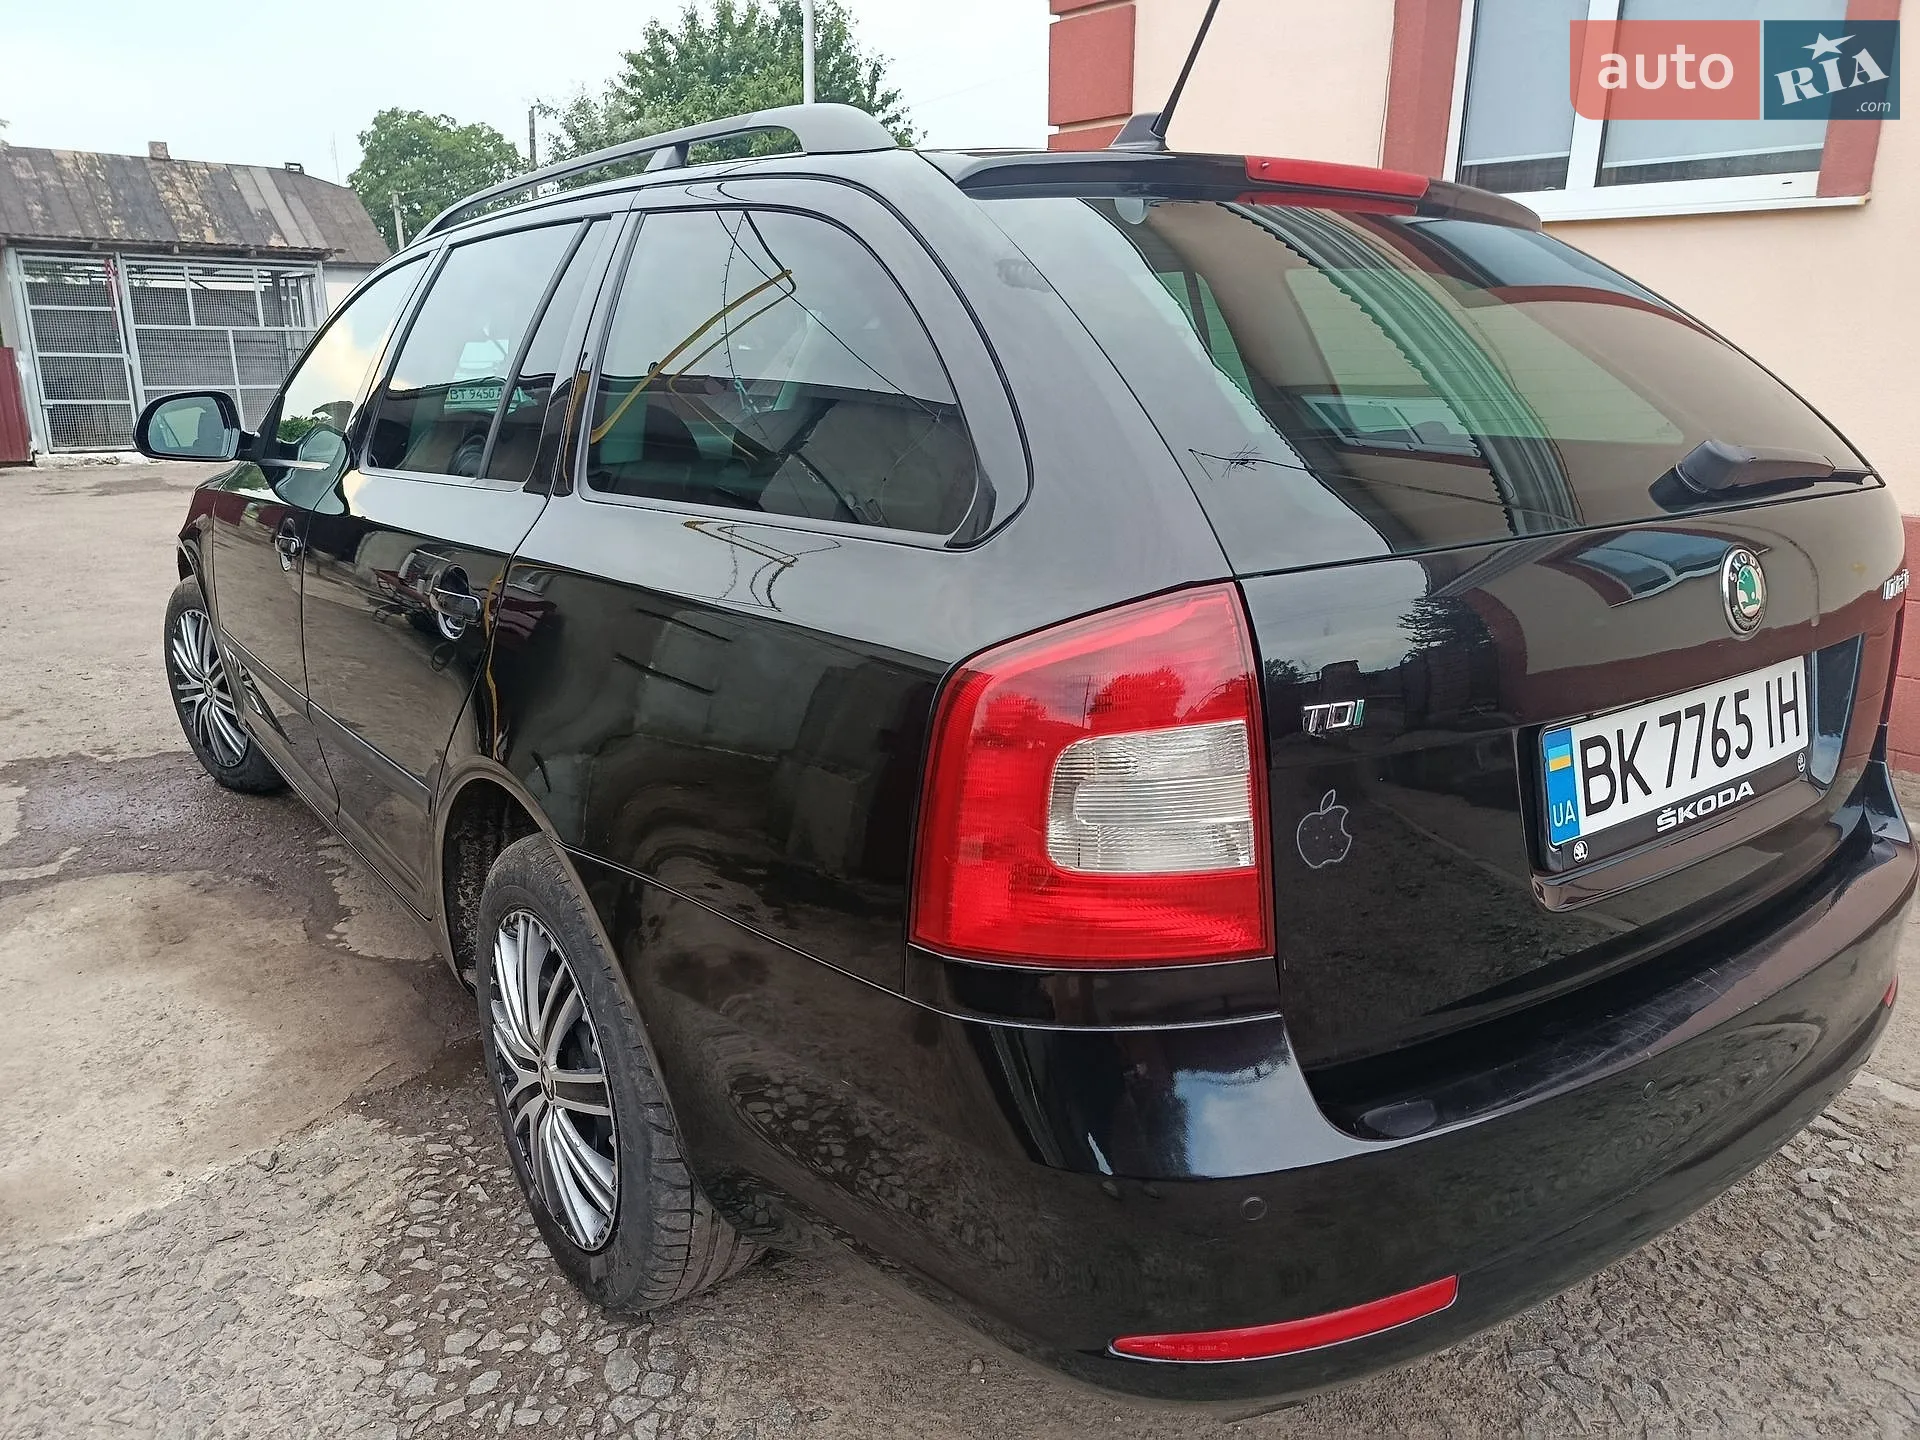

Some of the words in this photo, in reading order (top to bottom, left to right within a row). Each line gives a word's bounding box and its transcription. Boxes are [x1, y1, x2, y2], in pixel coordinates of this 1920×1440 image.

[450, 389, 467, 400] BT
[470, 388, 495, 399] 9450
[1304, 699, 1364, 733] TDI
[1579, 720, 1652, 817] BK
[1659, 688, 1753, 788] 7765
[1765, 671, 1800, 749] IH
[1553, 800, 1576, 828] UA
[1656, 780, 1755, 832] ŠKODA
